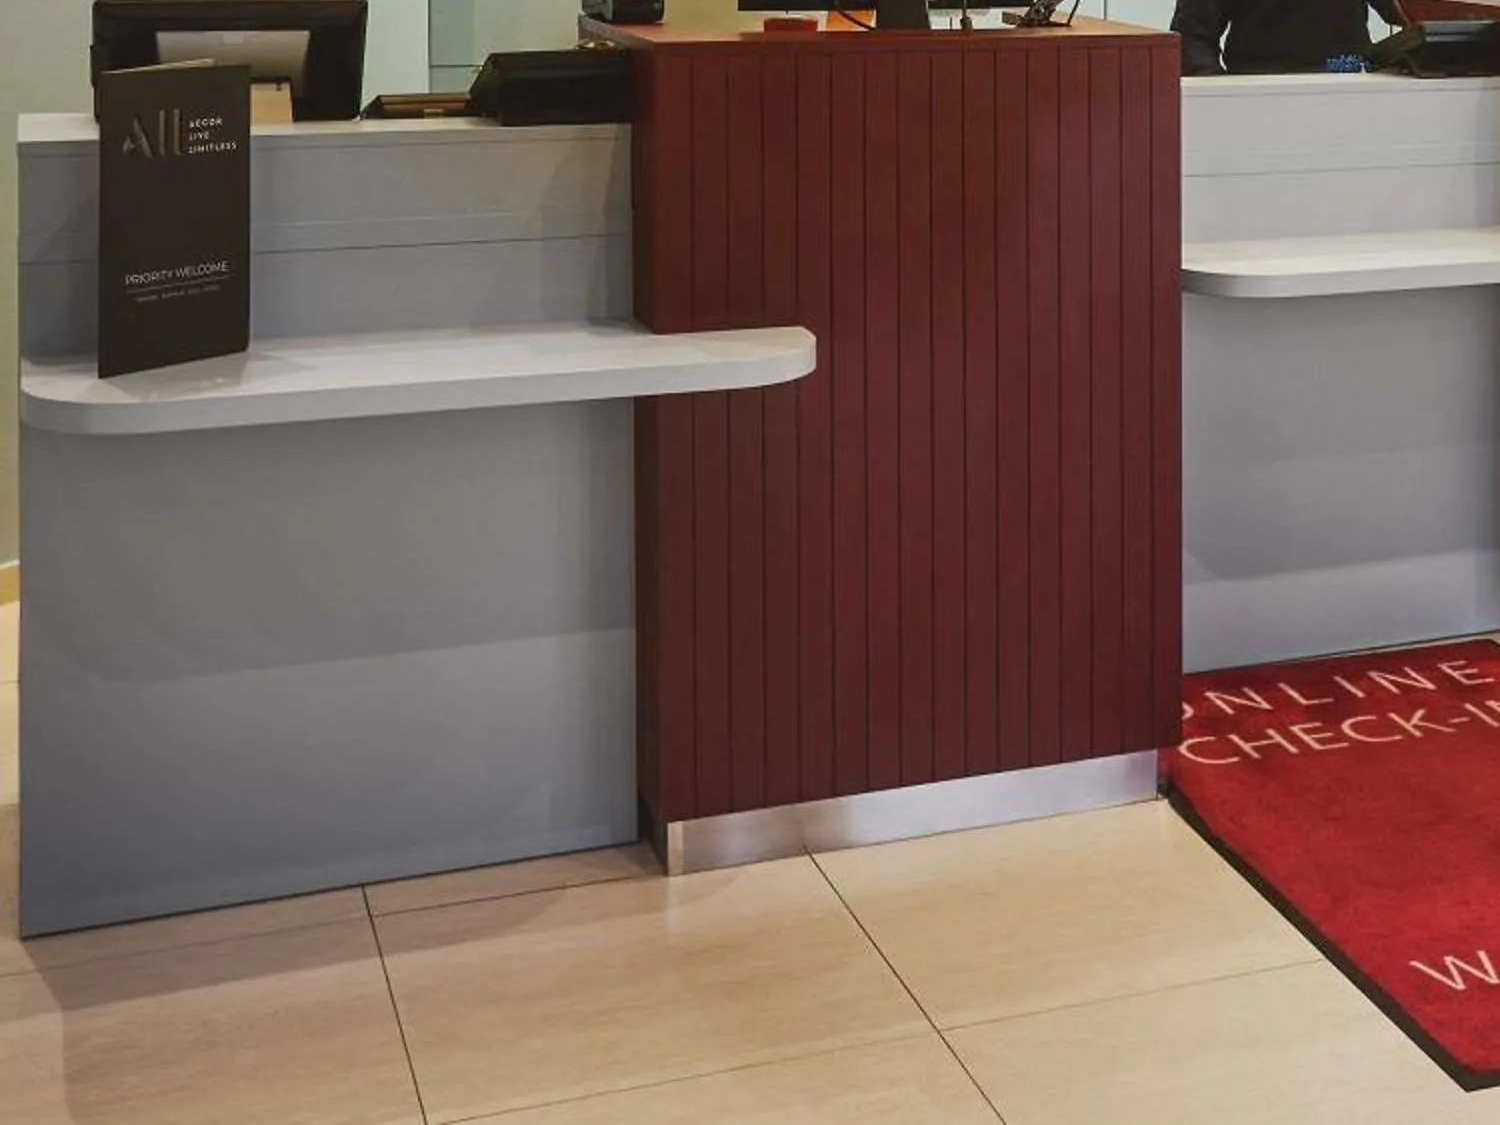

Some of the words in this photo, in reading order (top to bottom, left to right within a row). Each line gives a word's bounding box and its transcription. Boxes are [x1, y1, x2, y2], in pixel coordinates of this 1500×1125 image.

[121, 108, 181, 159] All
[189, 117, 223, 129] ACCOR
[125, 270, 173, 286] PRIORITY
[175, 260, 231, 278] WELCOME
[1181, 660, 1496, 721] NLINE
